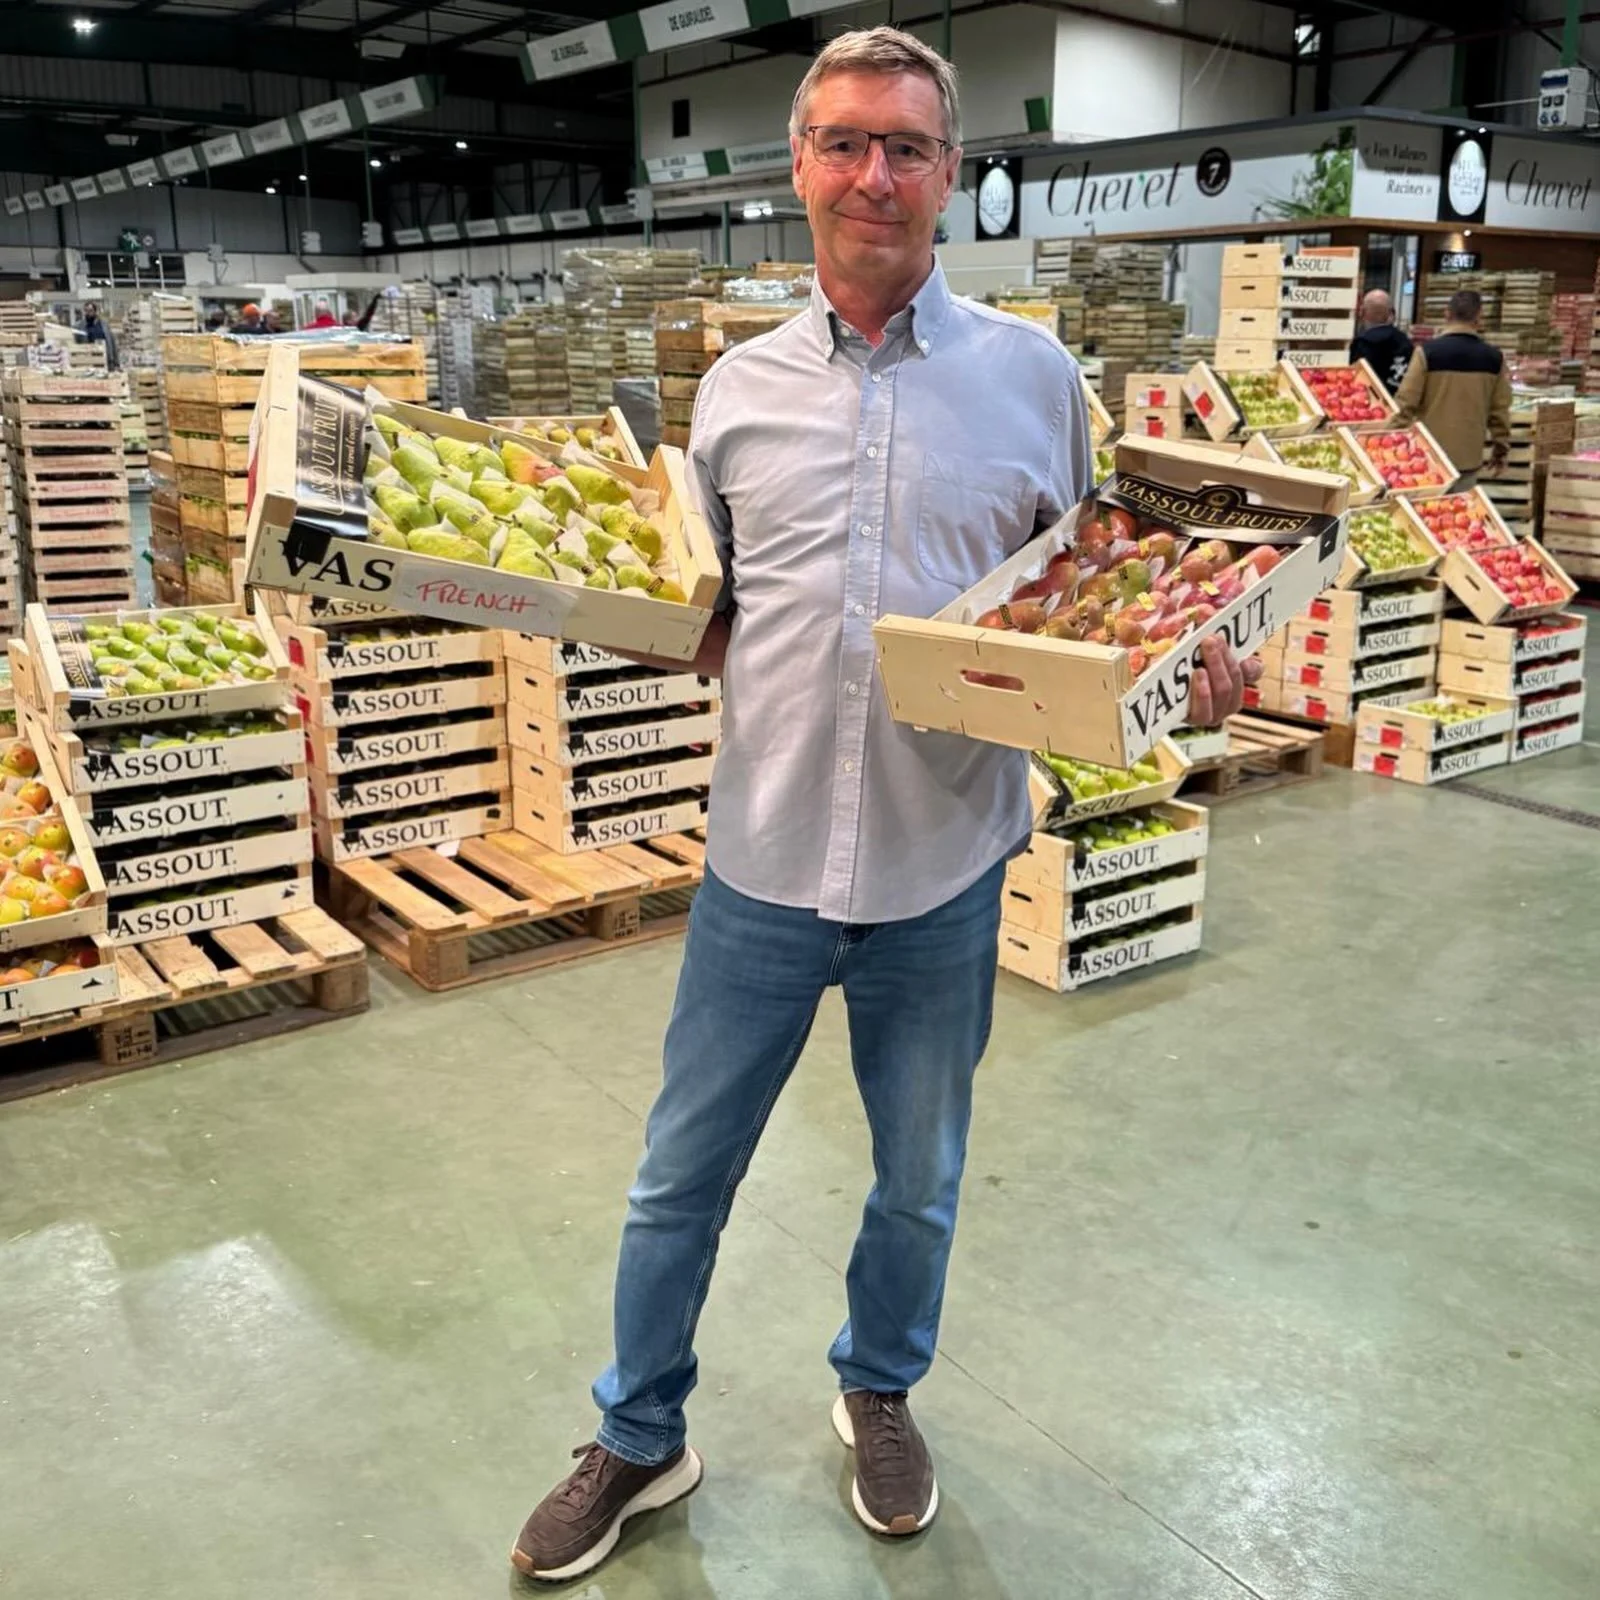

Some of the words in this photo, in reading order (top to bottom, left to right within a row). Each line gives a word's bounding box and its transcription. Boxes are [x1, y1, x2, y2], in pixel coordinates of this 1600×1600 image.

[1209, 161, 1220, 185] 7
[1048, 159, 1185, 217] Chevet
[1441, 253, 1476, 268] CHEVET
[1223, 512, 1302, 532] FRUITS
[416, 579, 538, 614] FRENCH
[107, 896, 239, 939] ASSOUT.
